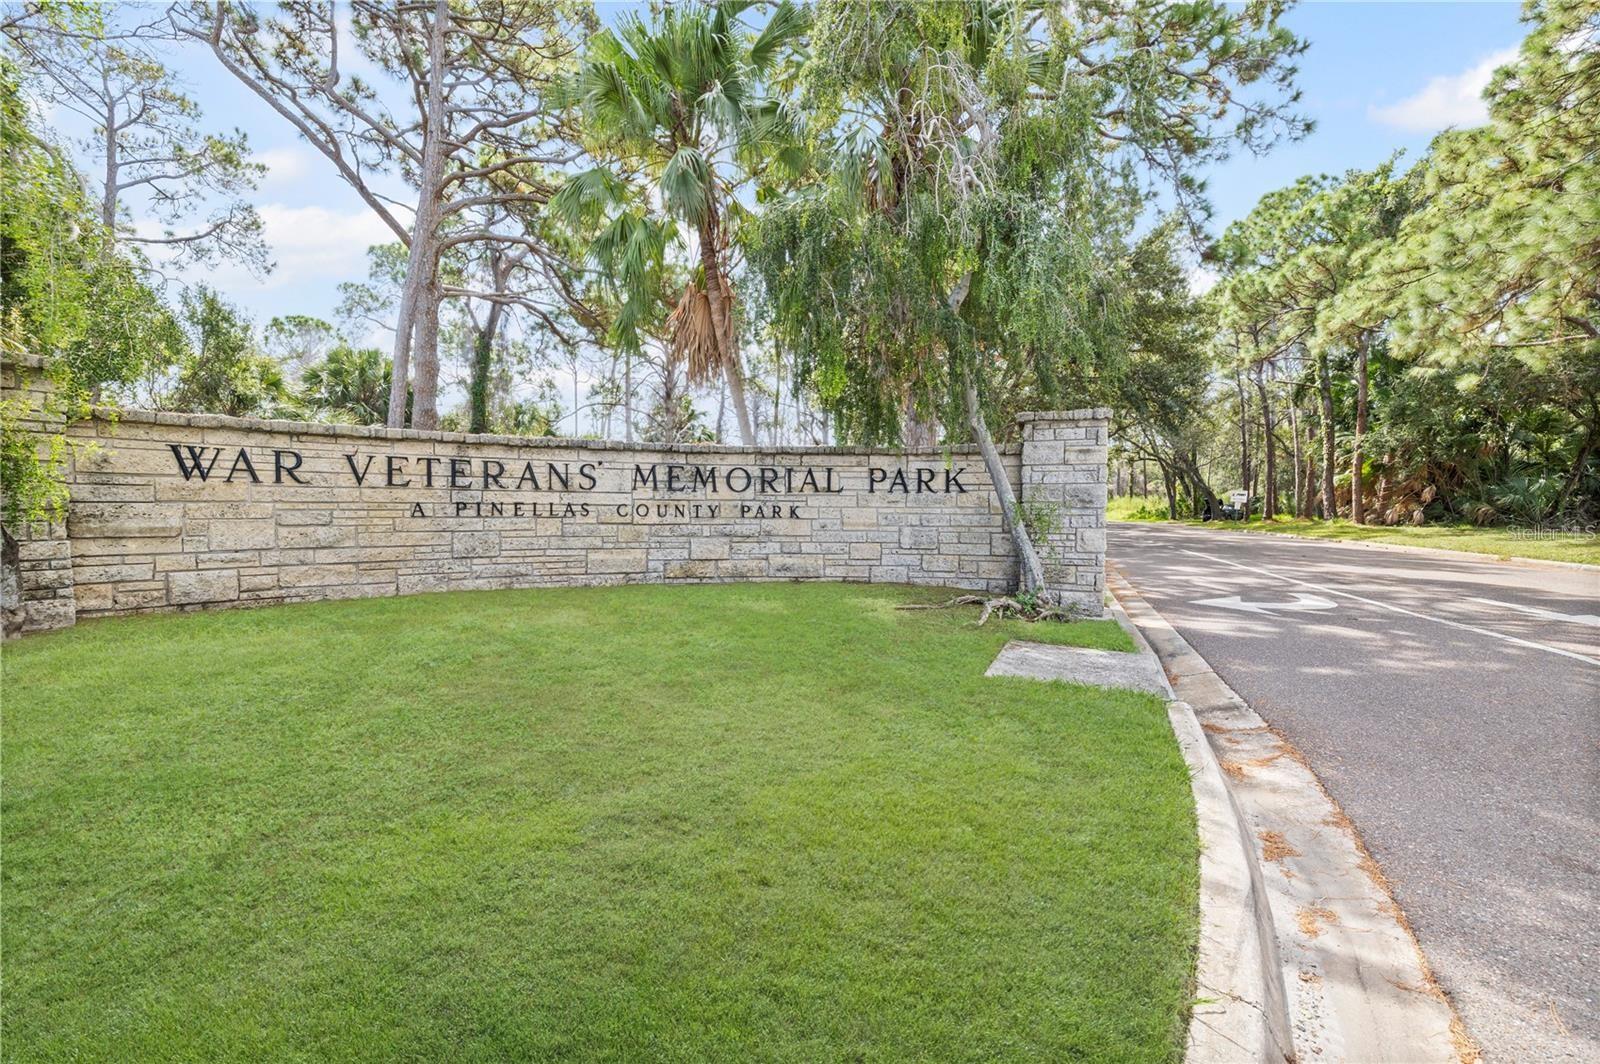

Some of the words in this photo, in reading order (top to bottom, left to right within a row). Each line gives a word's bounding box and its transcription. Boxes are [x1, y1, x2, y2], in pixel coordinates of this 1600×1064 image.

[167, 443, 311, 485] WAR
[343, 454, 603, 491] VETERANS'
[632, 464, 844, 493] MEMORIAL
[868, 467, 968, 493] PARK
[410, 502, 426, 518] A
[456, 502, 590, 518] PINELLAS
[616, 503, 719, 519] COUNTY
[740, 505, 801, 519] PARK
